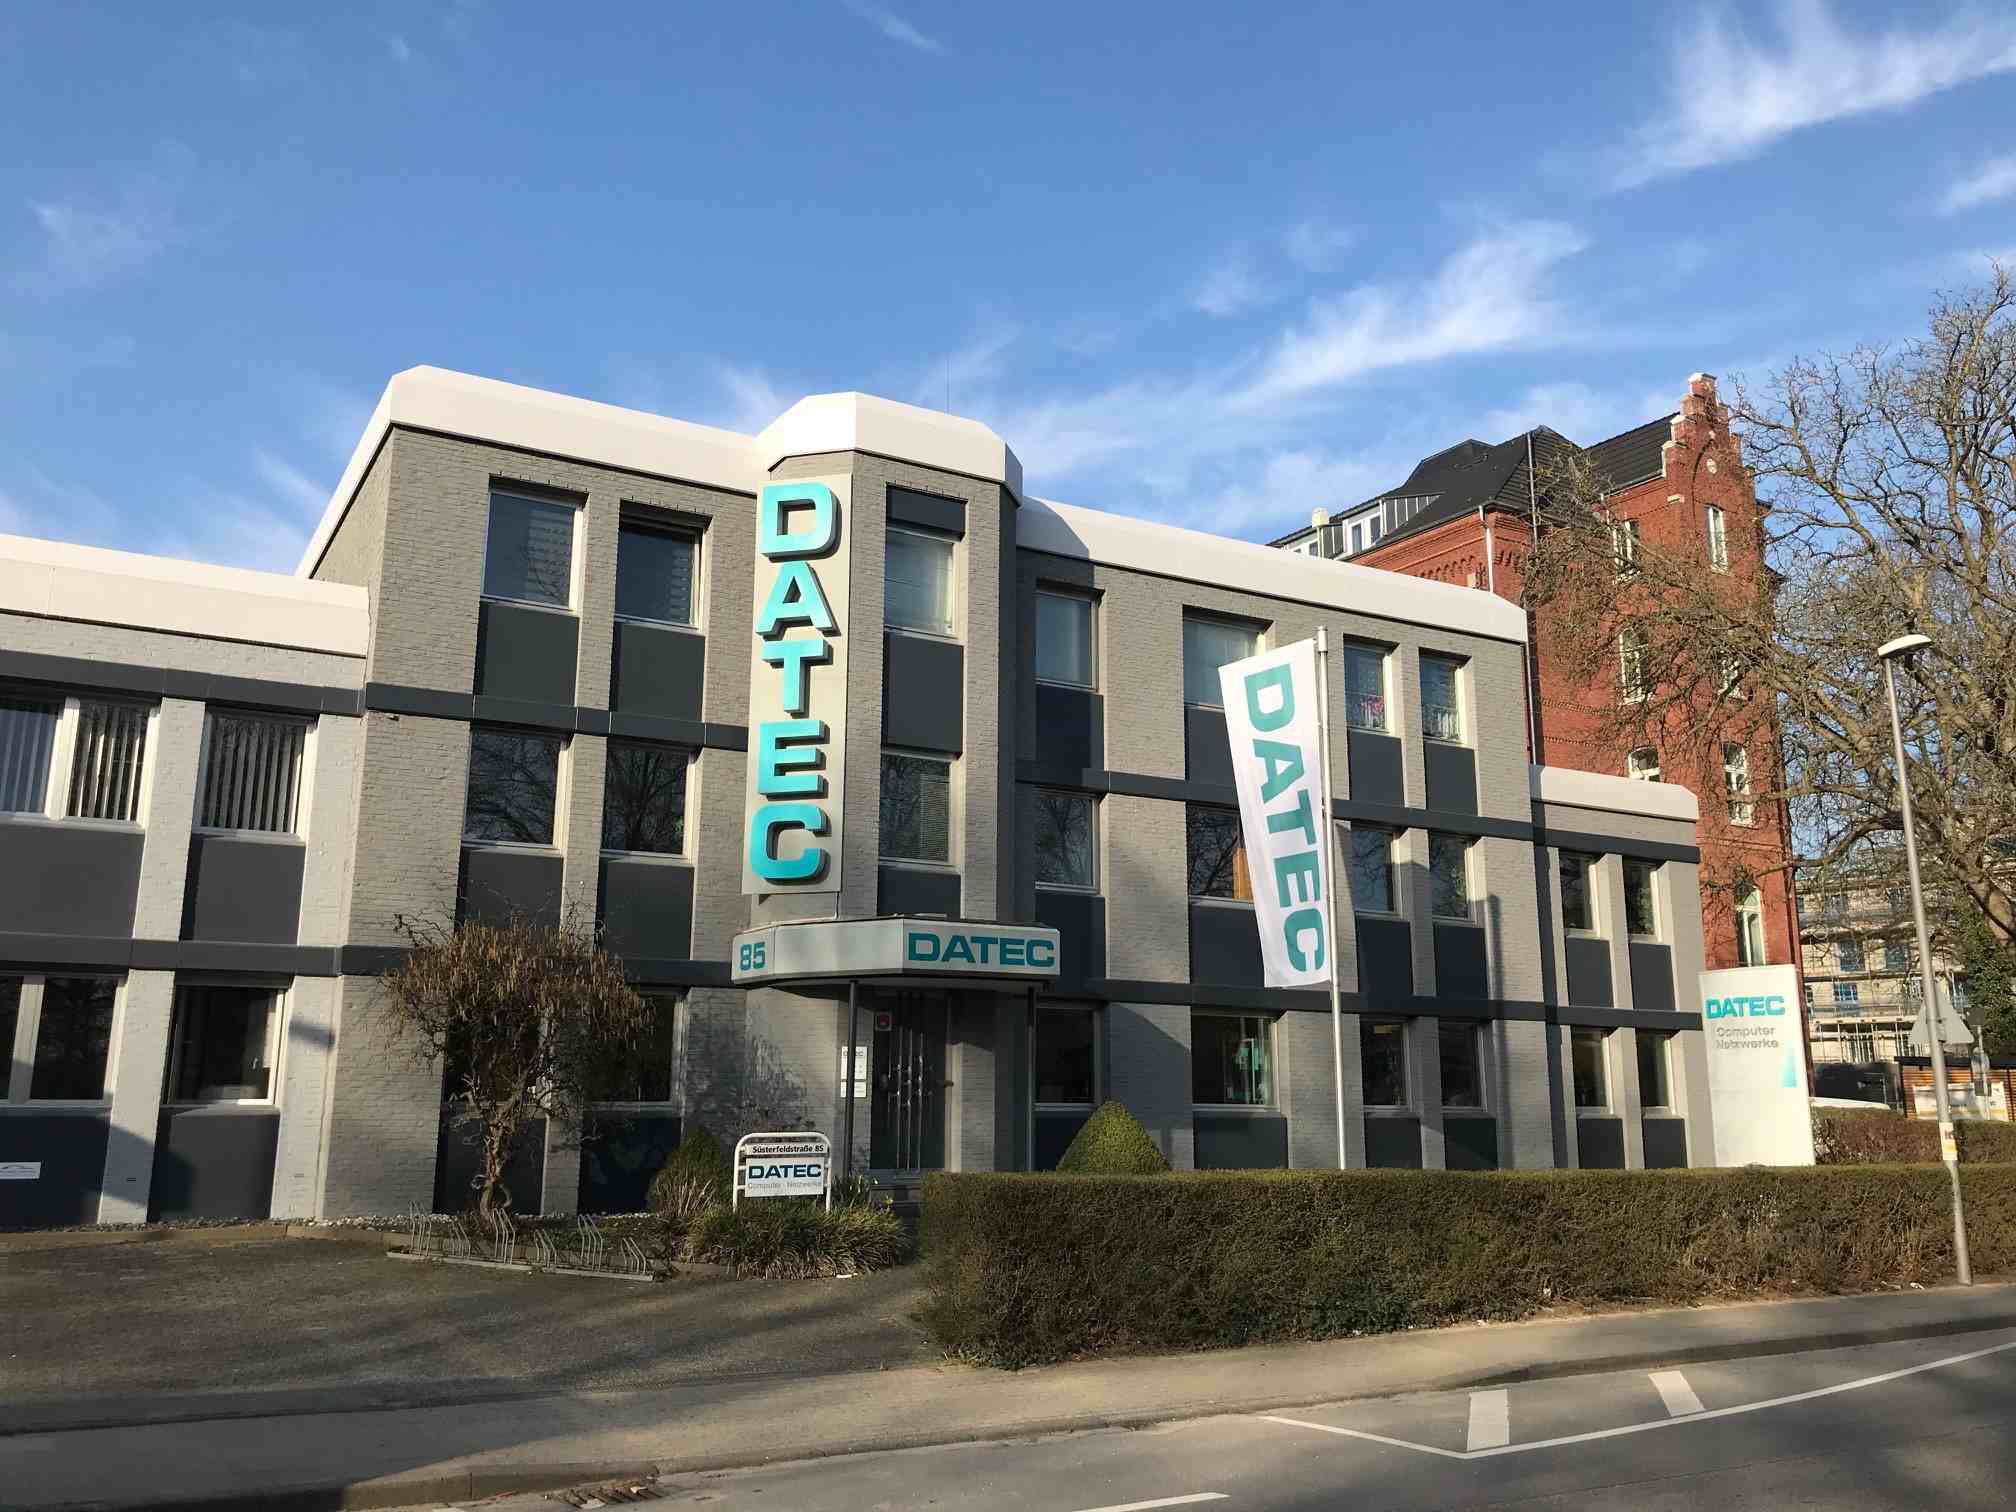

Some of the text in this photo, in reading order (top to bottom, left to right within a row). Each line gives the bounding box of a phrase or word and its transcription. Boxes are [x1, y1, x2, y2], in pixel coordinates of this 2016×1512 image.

[751, 482, 839, 881] DATEC
[1243, 663, 1325, 972] DATEC
[740, 941, 765, 970] 85
[908, 932, 1055, 967] DATEC
[1705, 995, 1785, 1019] DATEC
[1716, 1026, 1776, 1038] Computer
[752, 1145, 813, 1153] Süsterfeldstraße
[748, 1164, 821, 1179] DATEC
